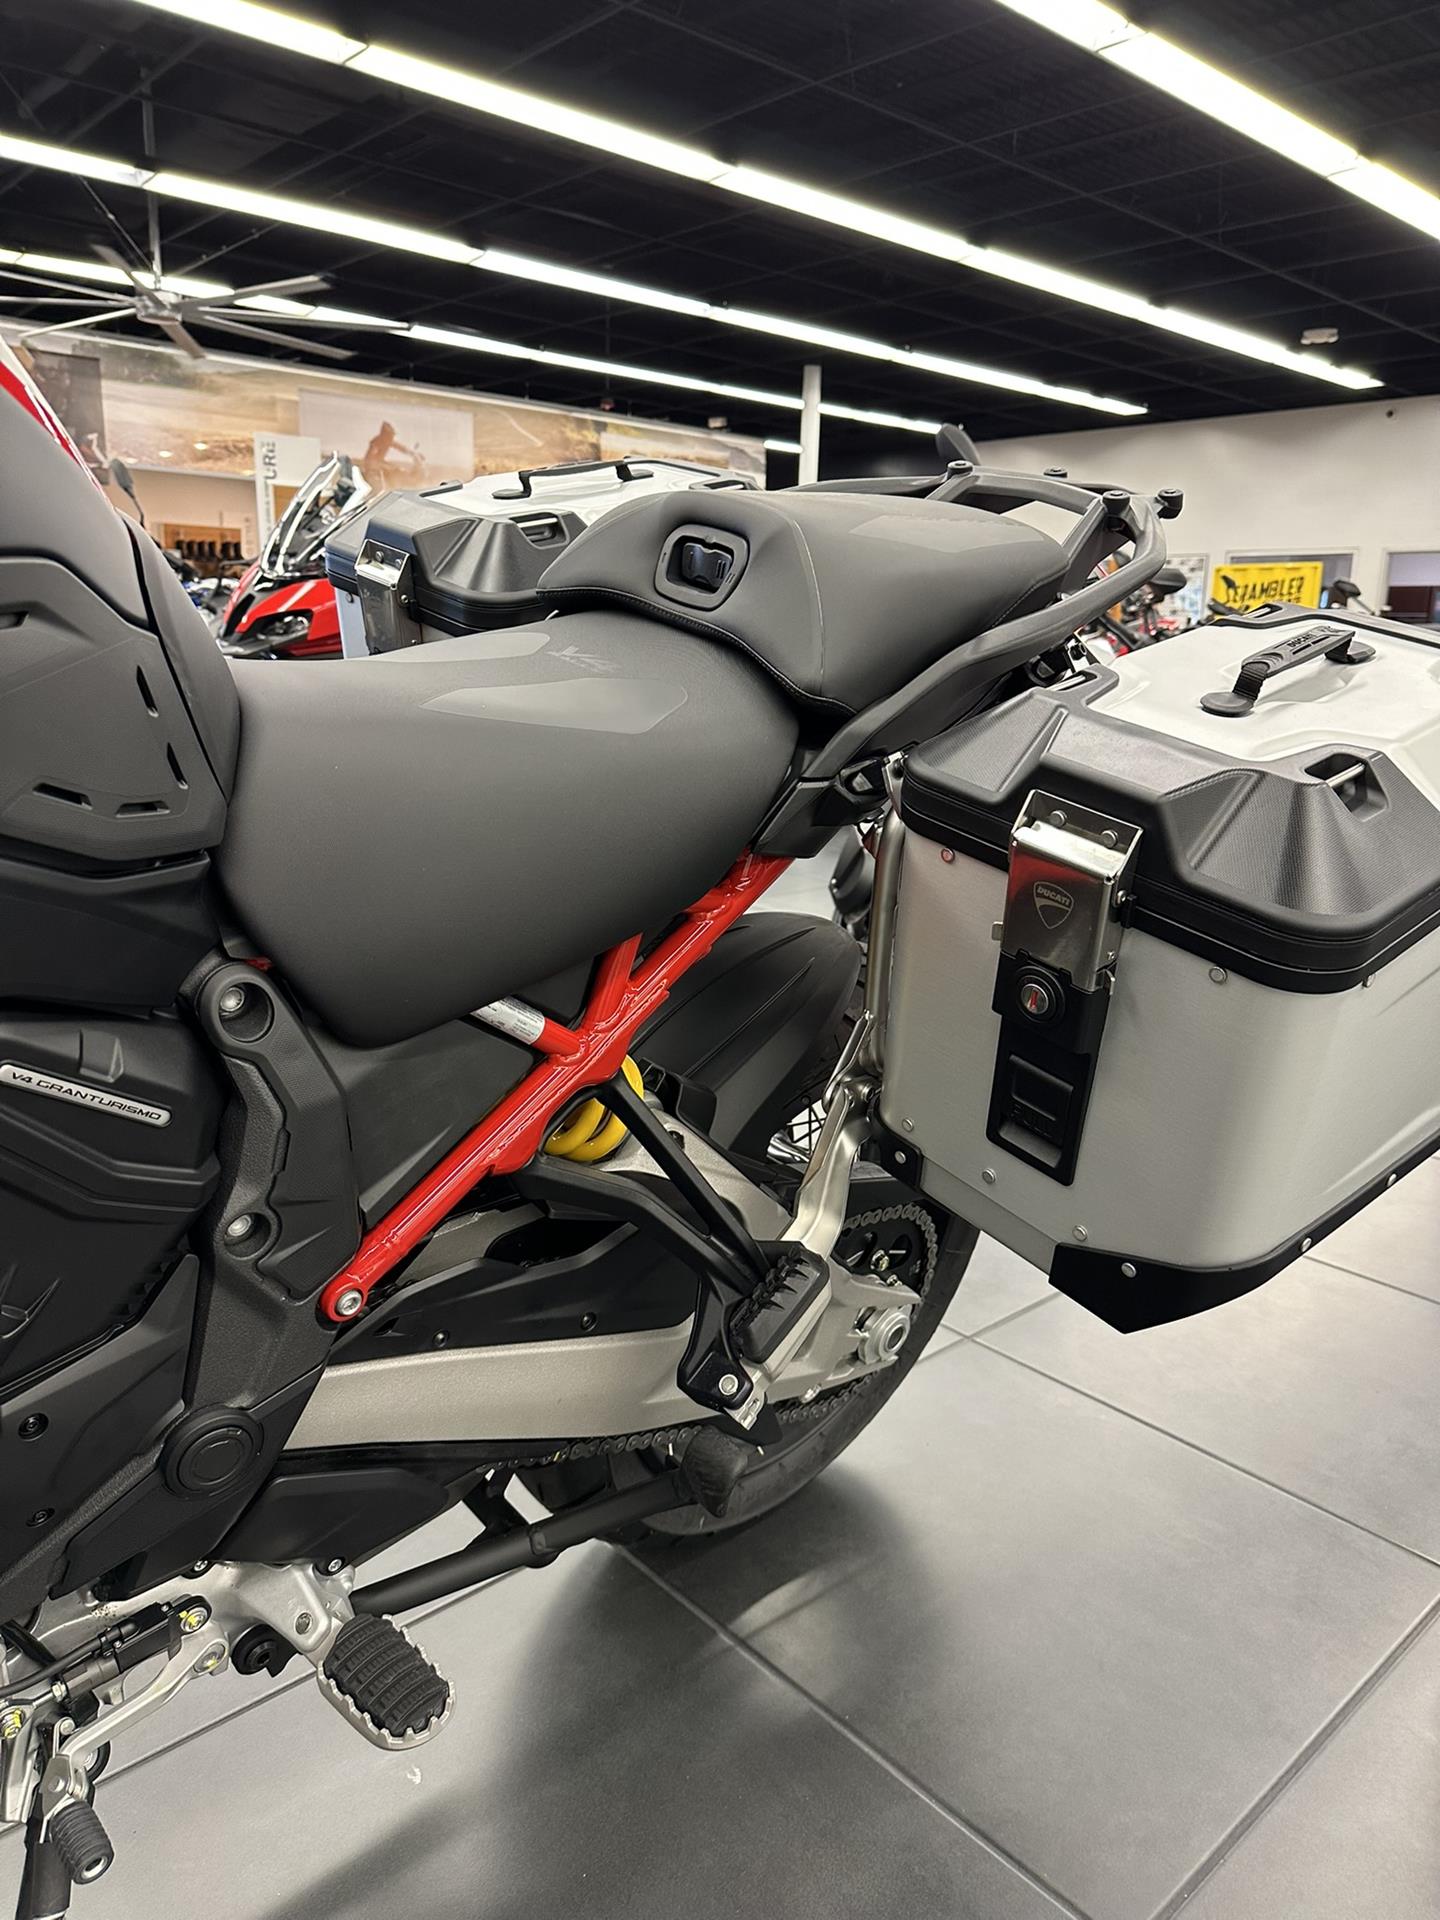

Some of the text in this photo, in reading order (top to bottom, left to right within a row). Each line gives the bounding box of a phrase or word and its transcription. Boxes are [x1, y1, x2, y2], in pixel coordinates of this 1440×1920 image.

[1036, 885, 1071, 906] DUCATI
[12, 1071, 162, 1121] V4 GRANTURISMO
